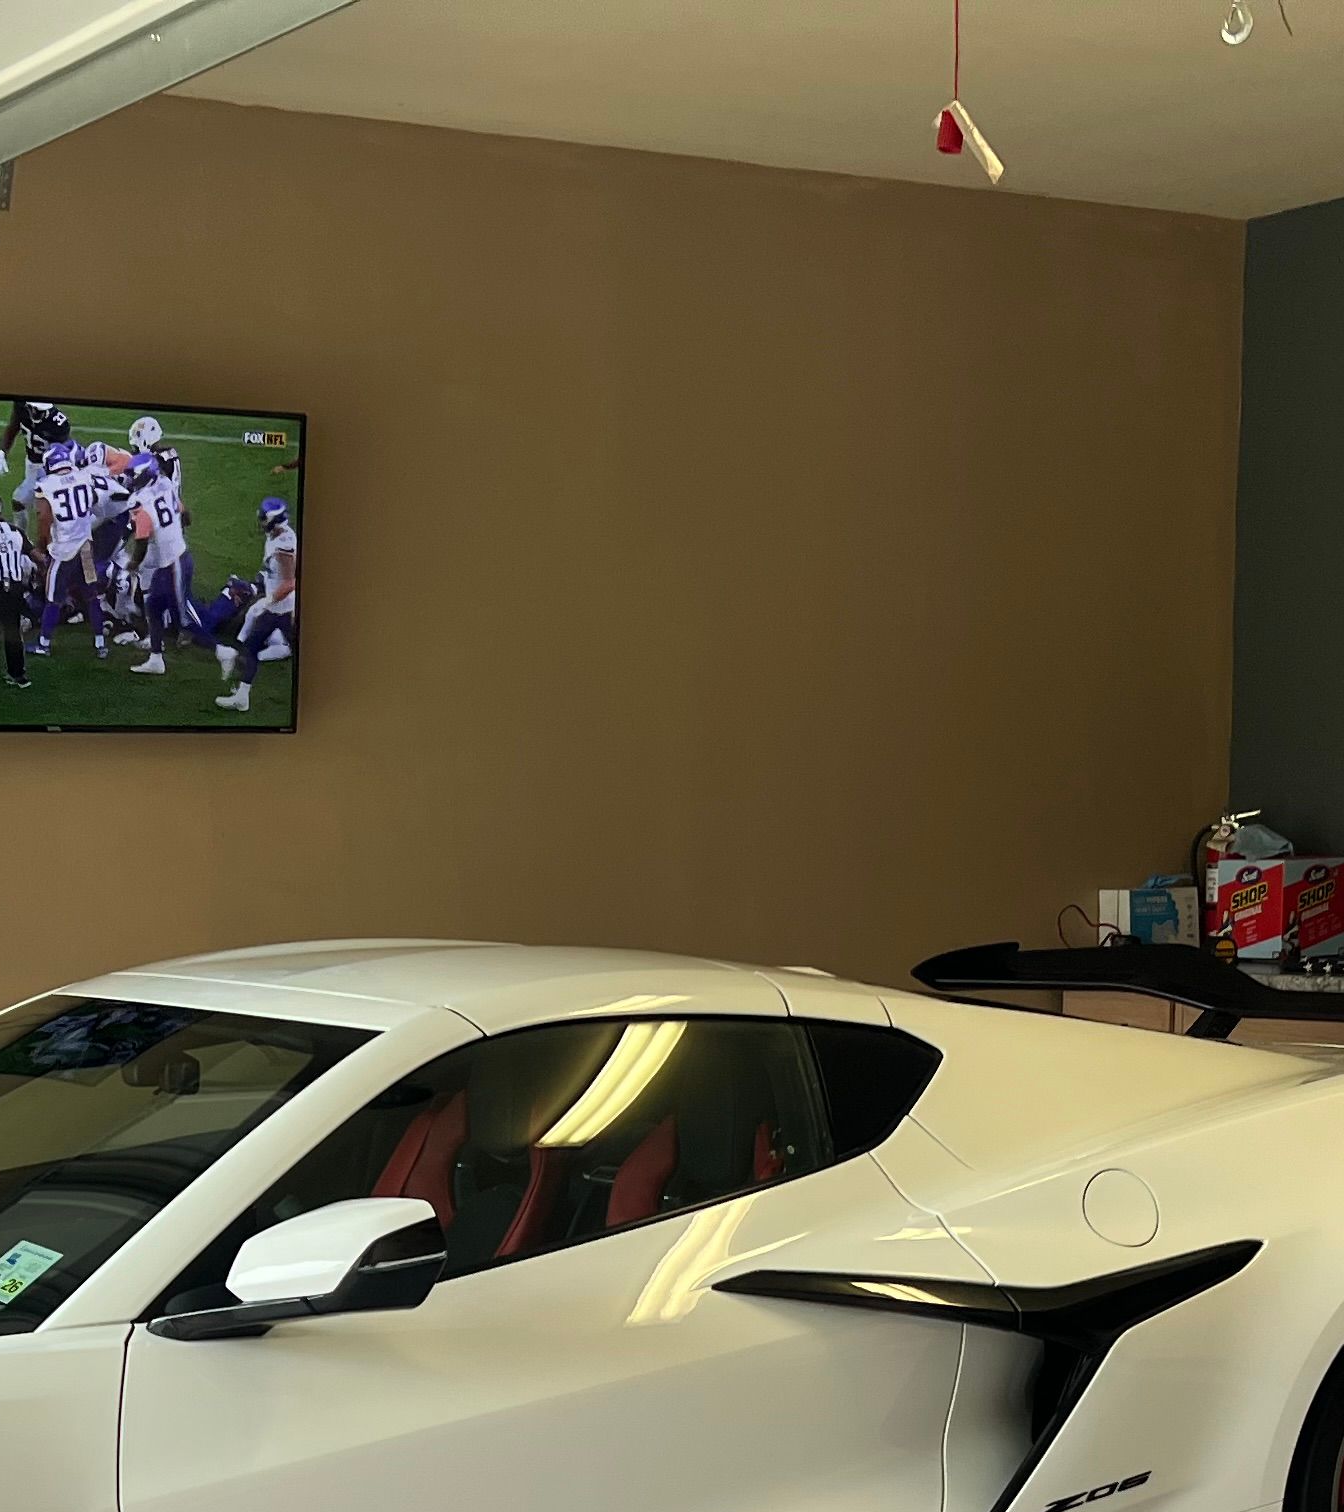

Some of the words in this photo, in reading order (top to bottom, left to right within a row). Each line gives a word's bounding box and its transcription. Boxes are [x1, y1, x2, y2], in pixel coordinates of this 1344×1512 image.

[244, 432, 264, 445] FOX
[266, 433, 285, 446] NFL
[53, 484, 89, 523] 30
[1231, 883, 1268, 910] SHOP
[1299, 882, 1335, 910] SHOP
[0, 1278, 24, 1294] 26
